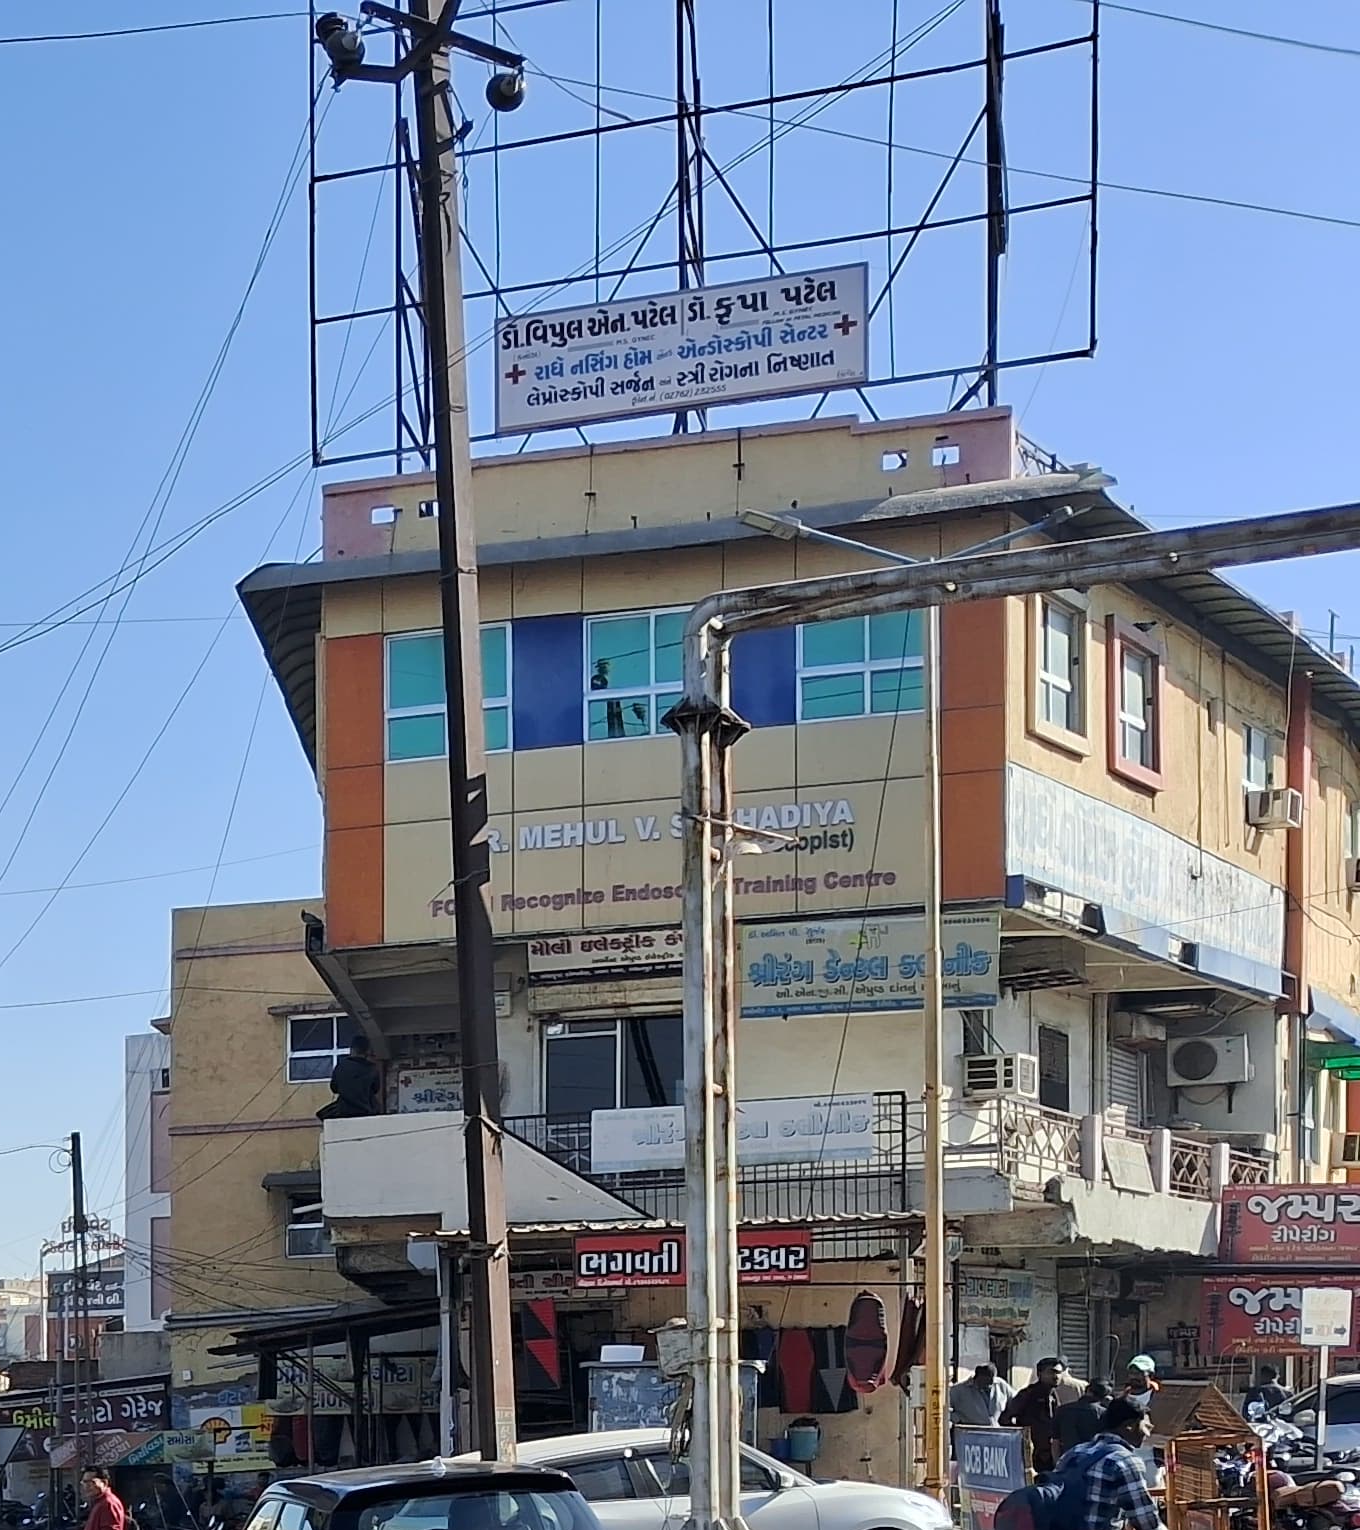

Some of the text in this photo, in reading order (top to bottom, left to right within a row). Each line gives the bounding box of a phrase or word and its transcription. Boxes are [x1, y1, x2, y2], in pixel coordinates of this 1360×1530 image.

[525, 316, 584, 348] વિપુલ
[587, 308, 631, 338] એન.
[631, 300, 678, 331] પટેલ
[688, 296, 711, 323] ડૉ.
[780, 276, 838, 307] પટેલ
[534, 356, 565, 381] રાધે
[623, 347, 653, 368] હોમ
[779, 322, 829, 346] સેન્ટર
[527, 376, 606, 407] લેપ્રોસ્કોપી
[610, 370, 656, 396] સર્જન
[677, 362, 705, 387] સ્ત્રી
[709, 359, 760, 383] રોગના
[766, 349, 835, 375] નિષ્ણાત
[520, 818, 626, 851] MEHUL
[635, 815, 660, 841] V.
[500, 888, 606, 912] Recognize
[733, 873, 817, 896] Training
[823, 870, 897, 890] Centre
[748, 952, 815, 988] શ્રીરંગ
[580, 1240, 679, 1275] ભગવતી
[964, 1444, 1009, 1478] DCB BANK
